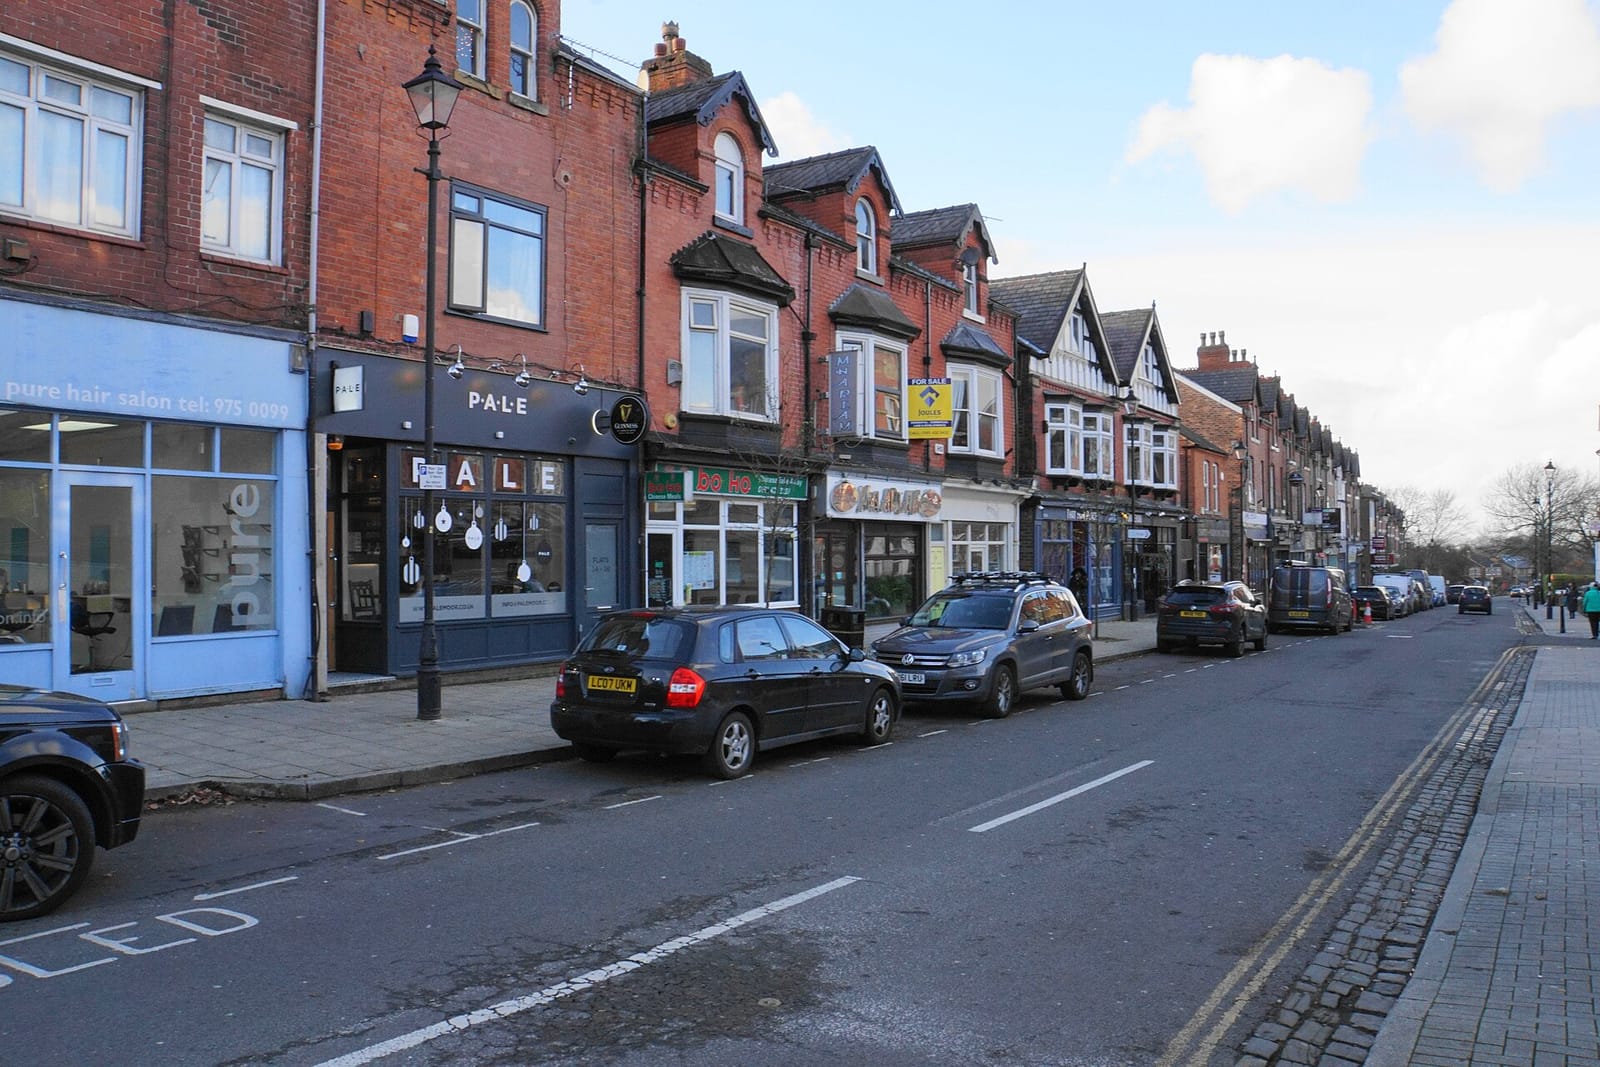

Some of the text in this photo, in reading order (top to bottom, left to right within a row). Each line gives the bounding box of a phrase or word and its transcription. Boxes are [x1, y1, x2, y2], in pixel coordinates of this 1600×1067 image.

[6, 381, 289, 421] pure hair salon tel: 975 0099
[231, 484, 272, 626] pure
[0, 908, 259, 988] LED
